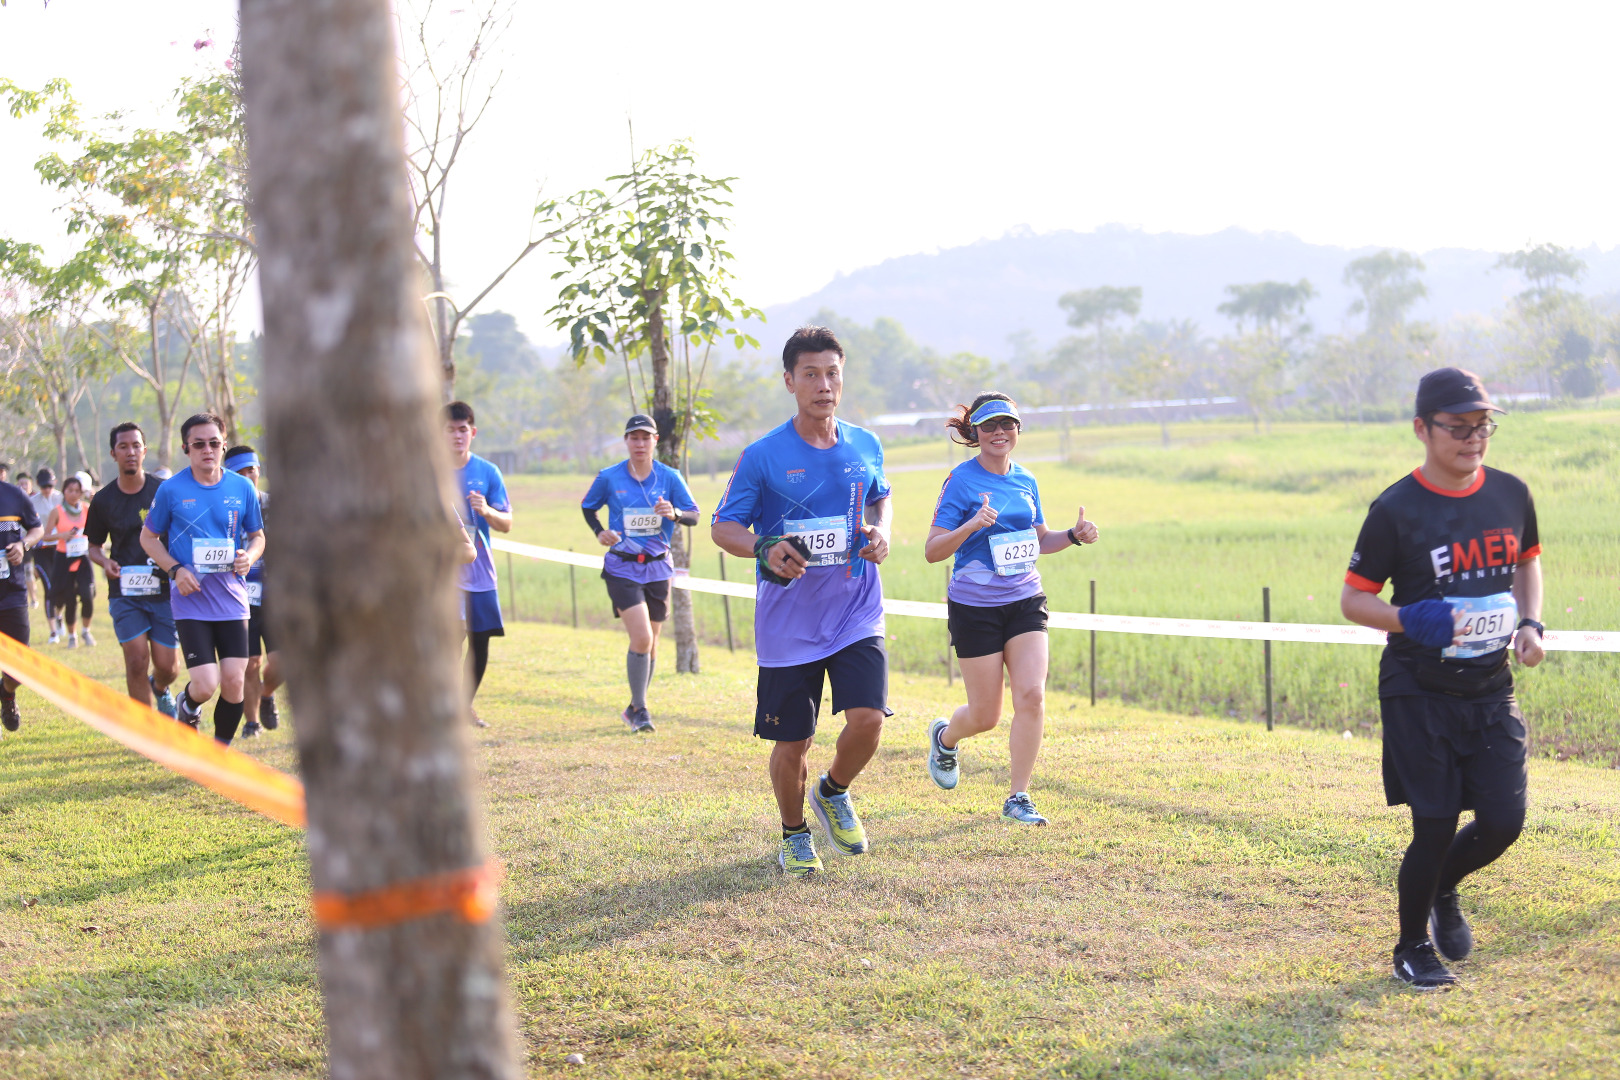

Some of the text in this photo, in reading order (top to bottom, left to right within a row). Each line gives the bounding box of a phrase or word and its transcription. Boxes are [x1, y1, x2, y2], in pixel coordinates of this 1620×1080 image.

[630, 516, 658, 526] 6058
[802, 532, 836, 550] 158
[204, 550, 228, 560] 6191
[1004, 544, 1034, 560] 6232
[128, 576, 153, 586] 6276
[1464, 614, 1504, 636] 6051
